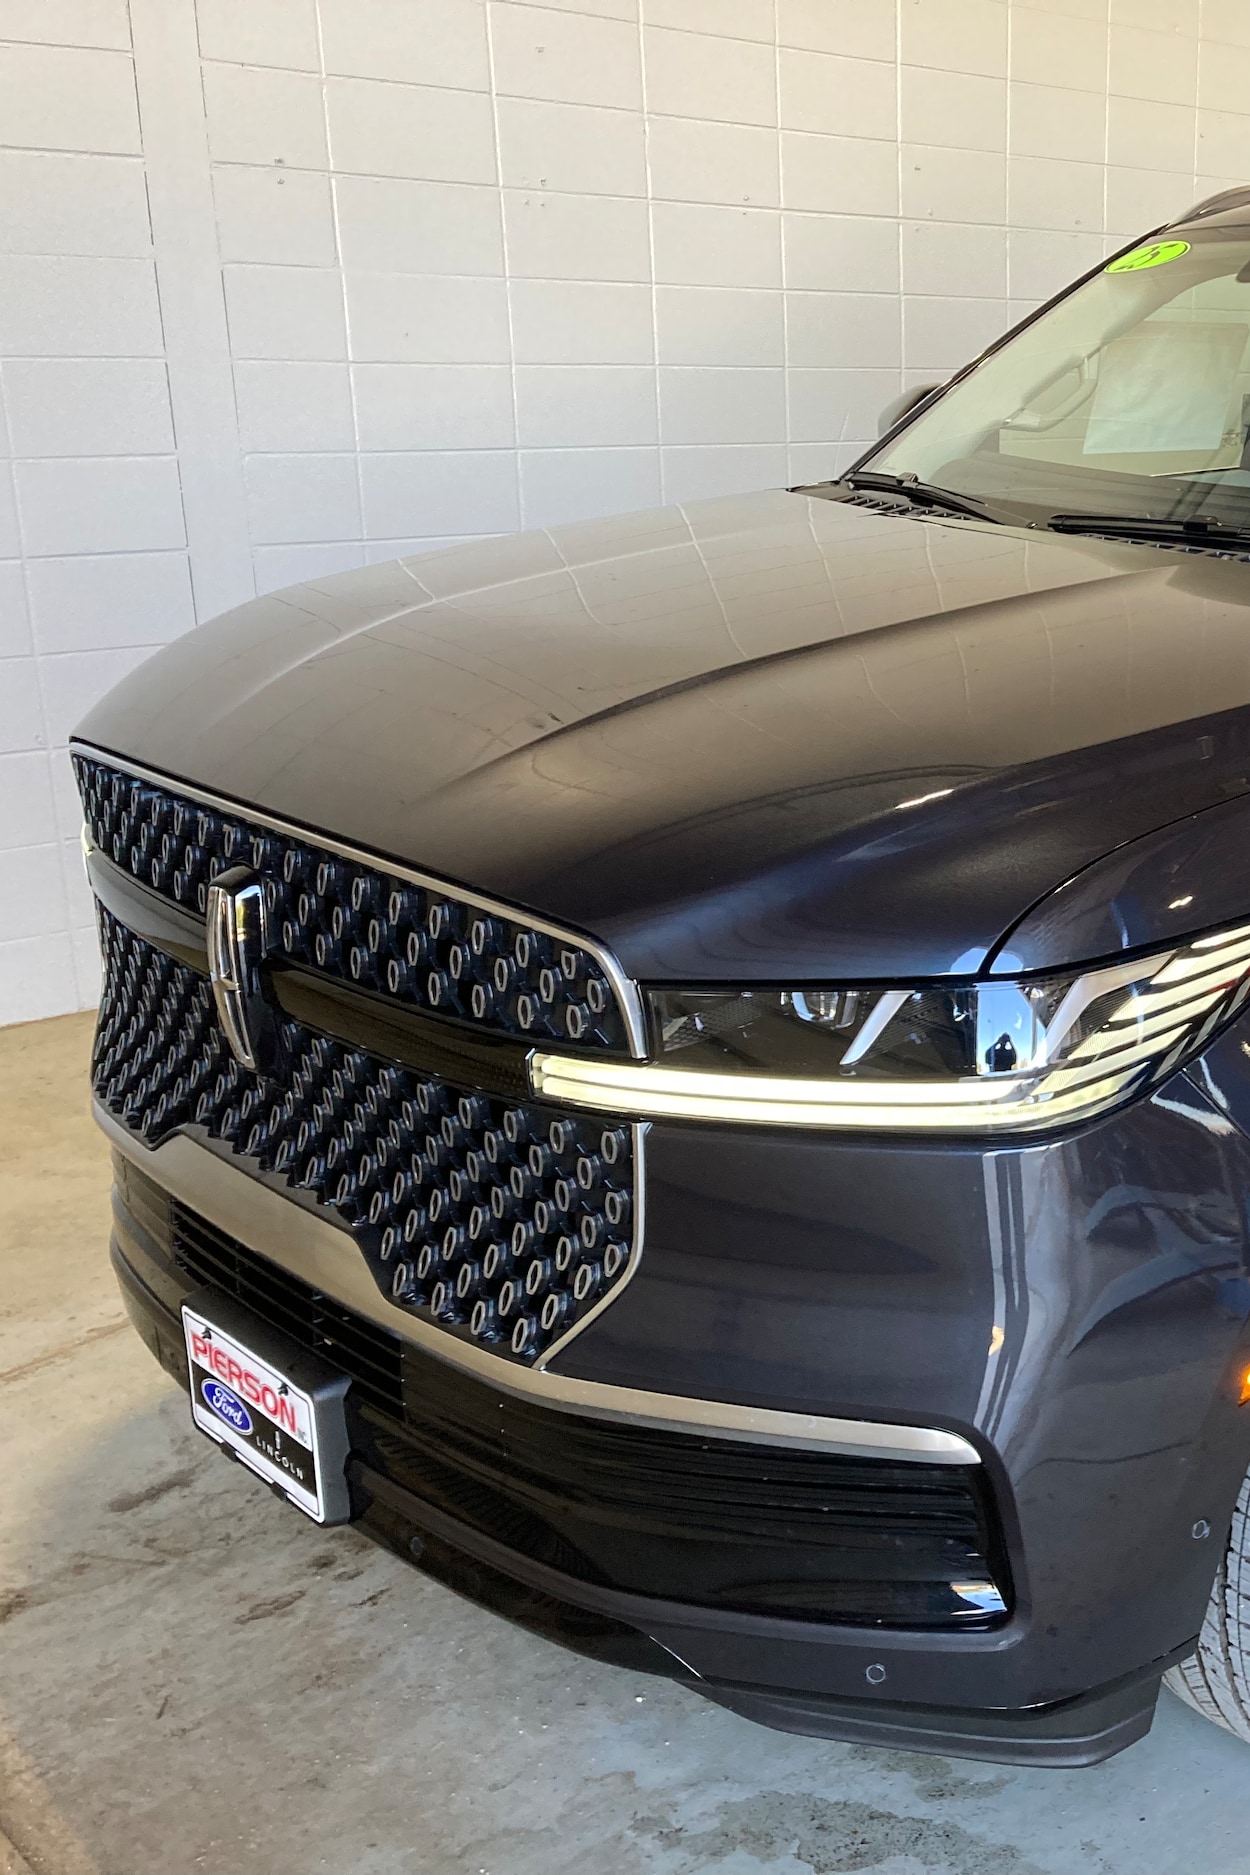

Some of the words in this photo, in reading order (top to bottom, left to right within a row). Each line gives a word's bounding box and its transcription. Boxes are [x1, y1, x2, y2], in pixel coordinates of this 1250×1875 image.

[190, 1332, 297, 1433] PIERSON
[212, 1386, 244, 1427] Ford
[255, 1435, 304, 1481] LINCOLN
